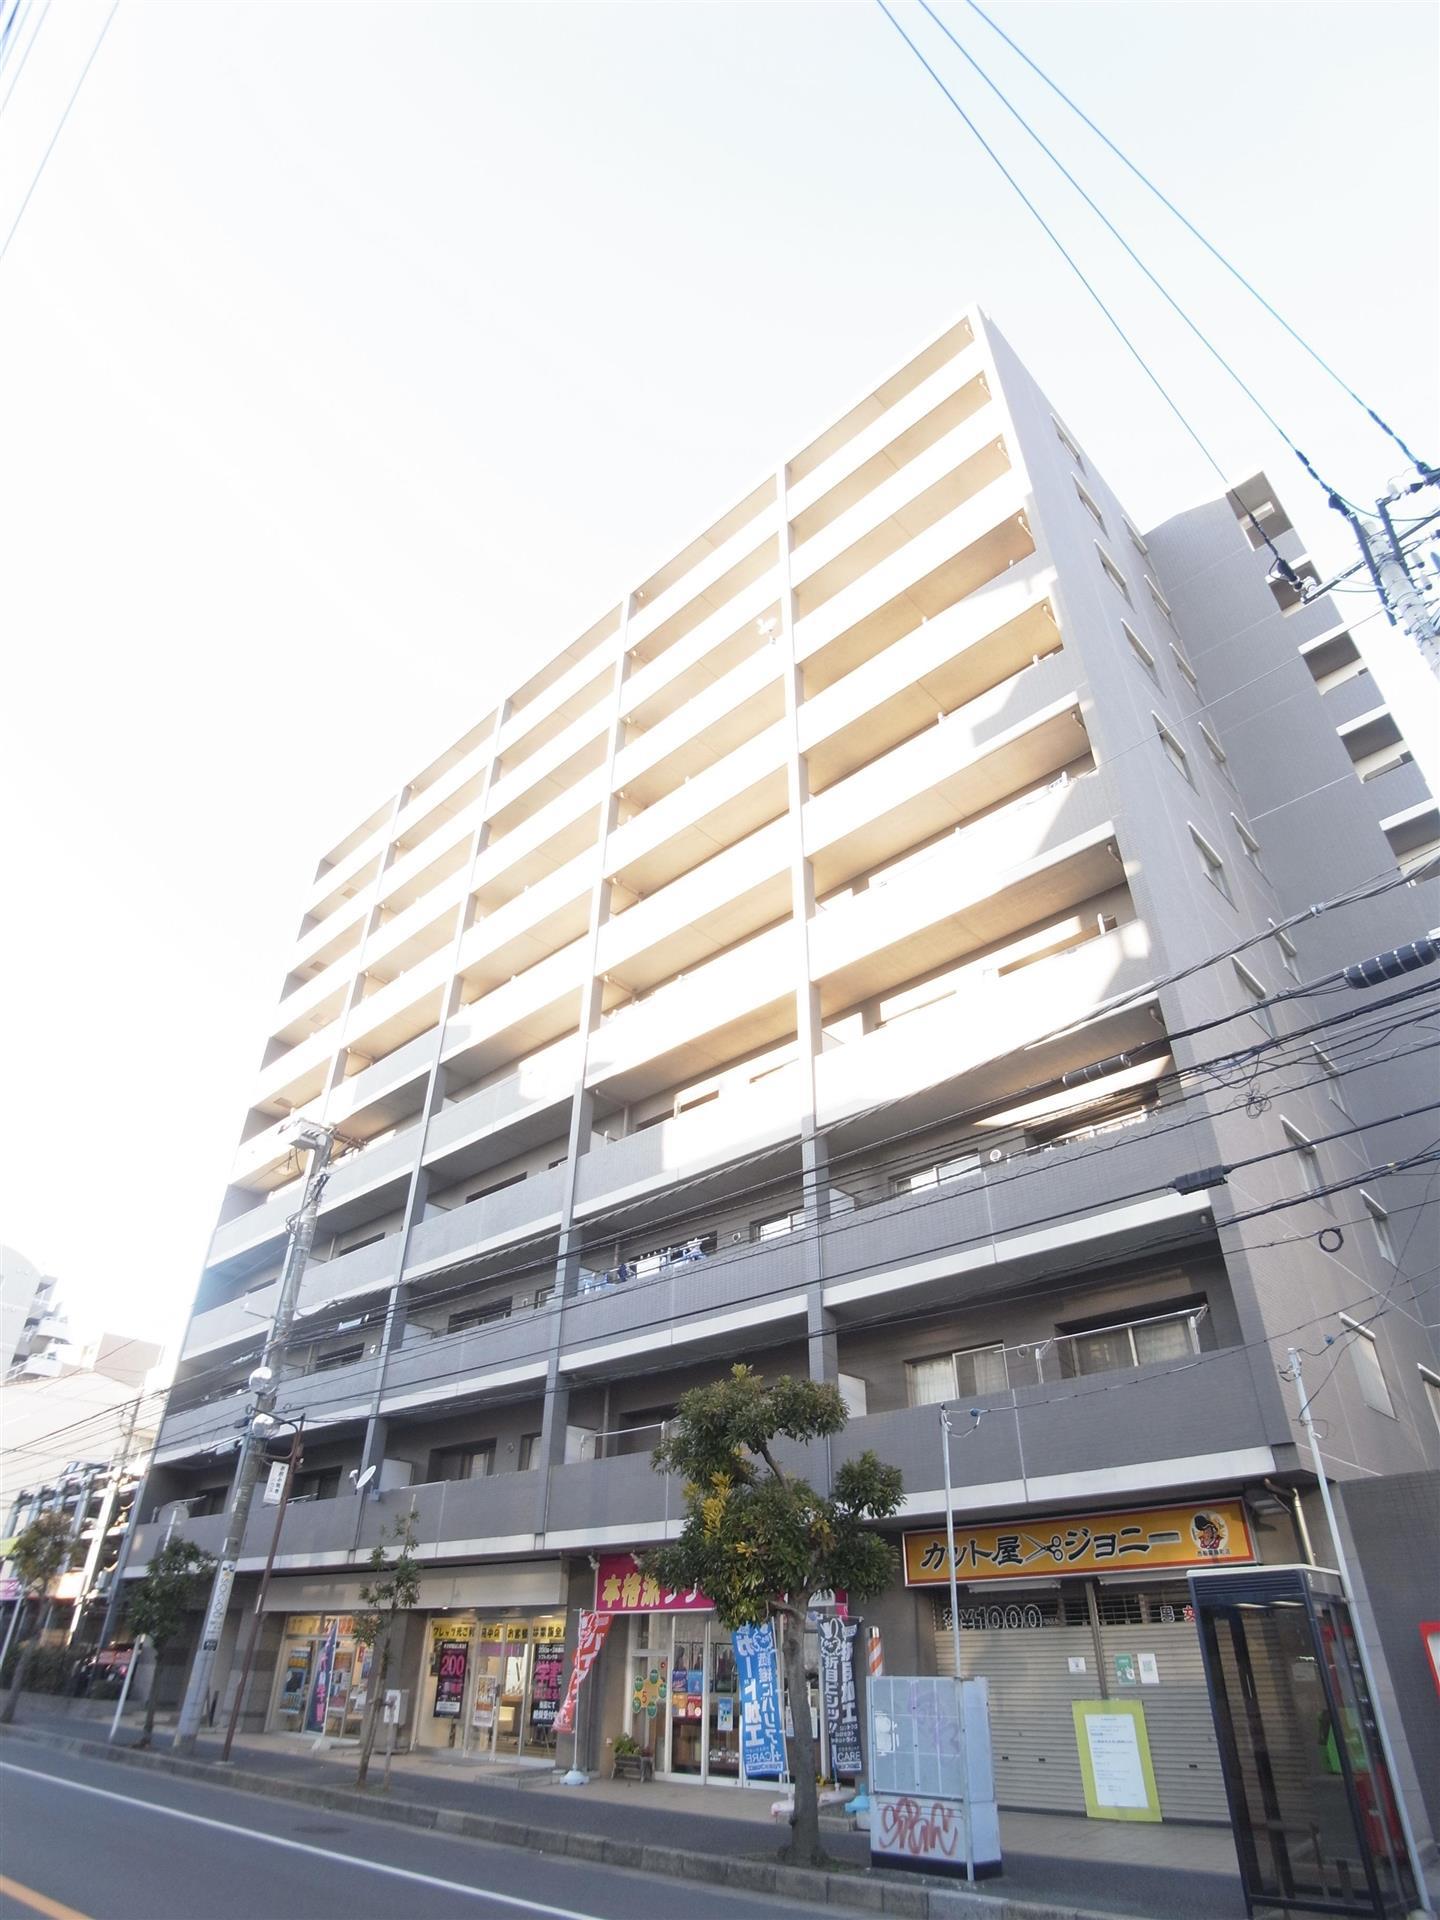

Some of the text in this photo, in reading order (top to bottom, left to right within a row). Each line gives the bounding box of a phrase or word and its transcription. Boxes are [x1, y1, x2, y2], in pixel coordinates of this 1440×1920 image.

[921, 1527, 1181, 1570] カット屋 ジョニー
[837, 1751, 861, 1762] CARE
